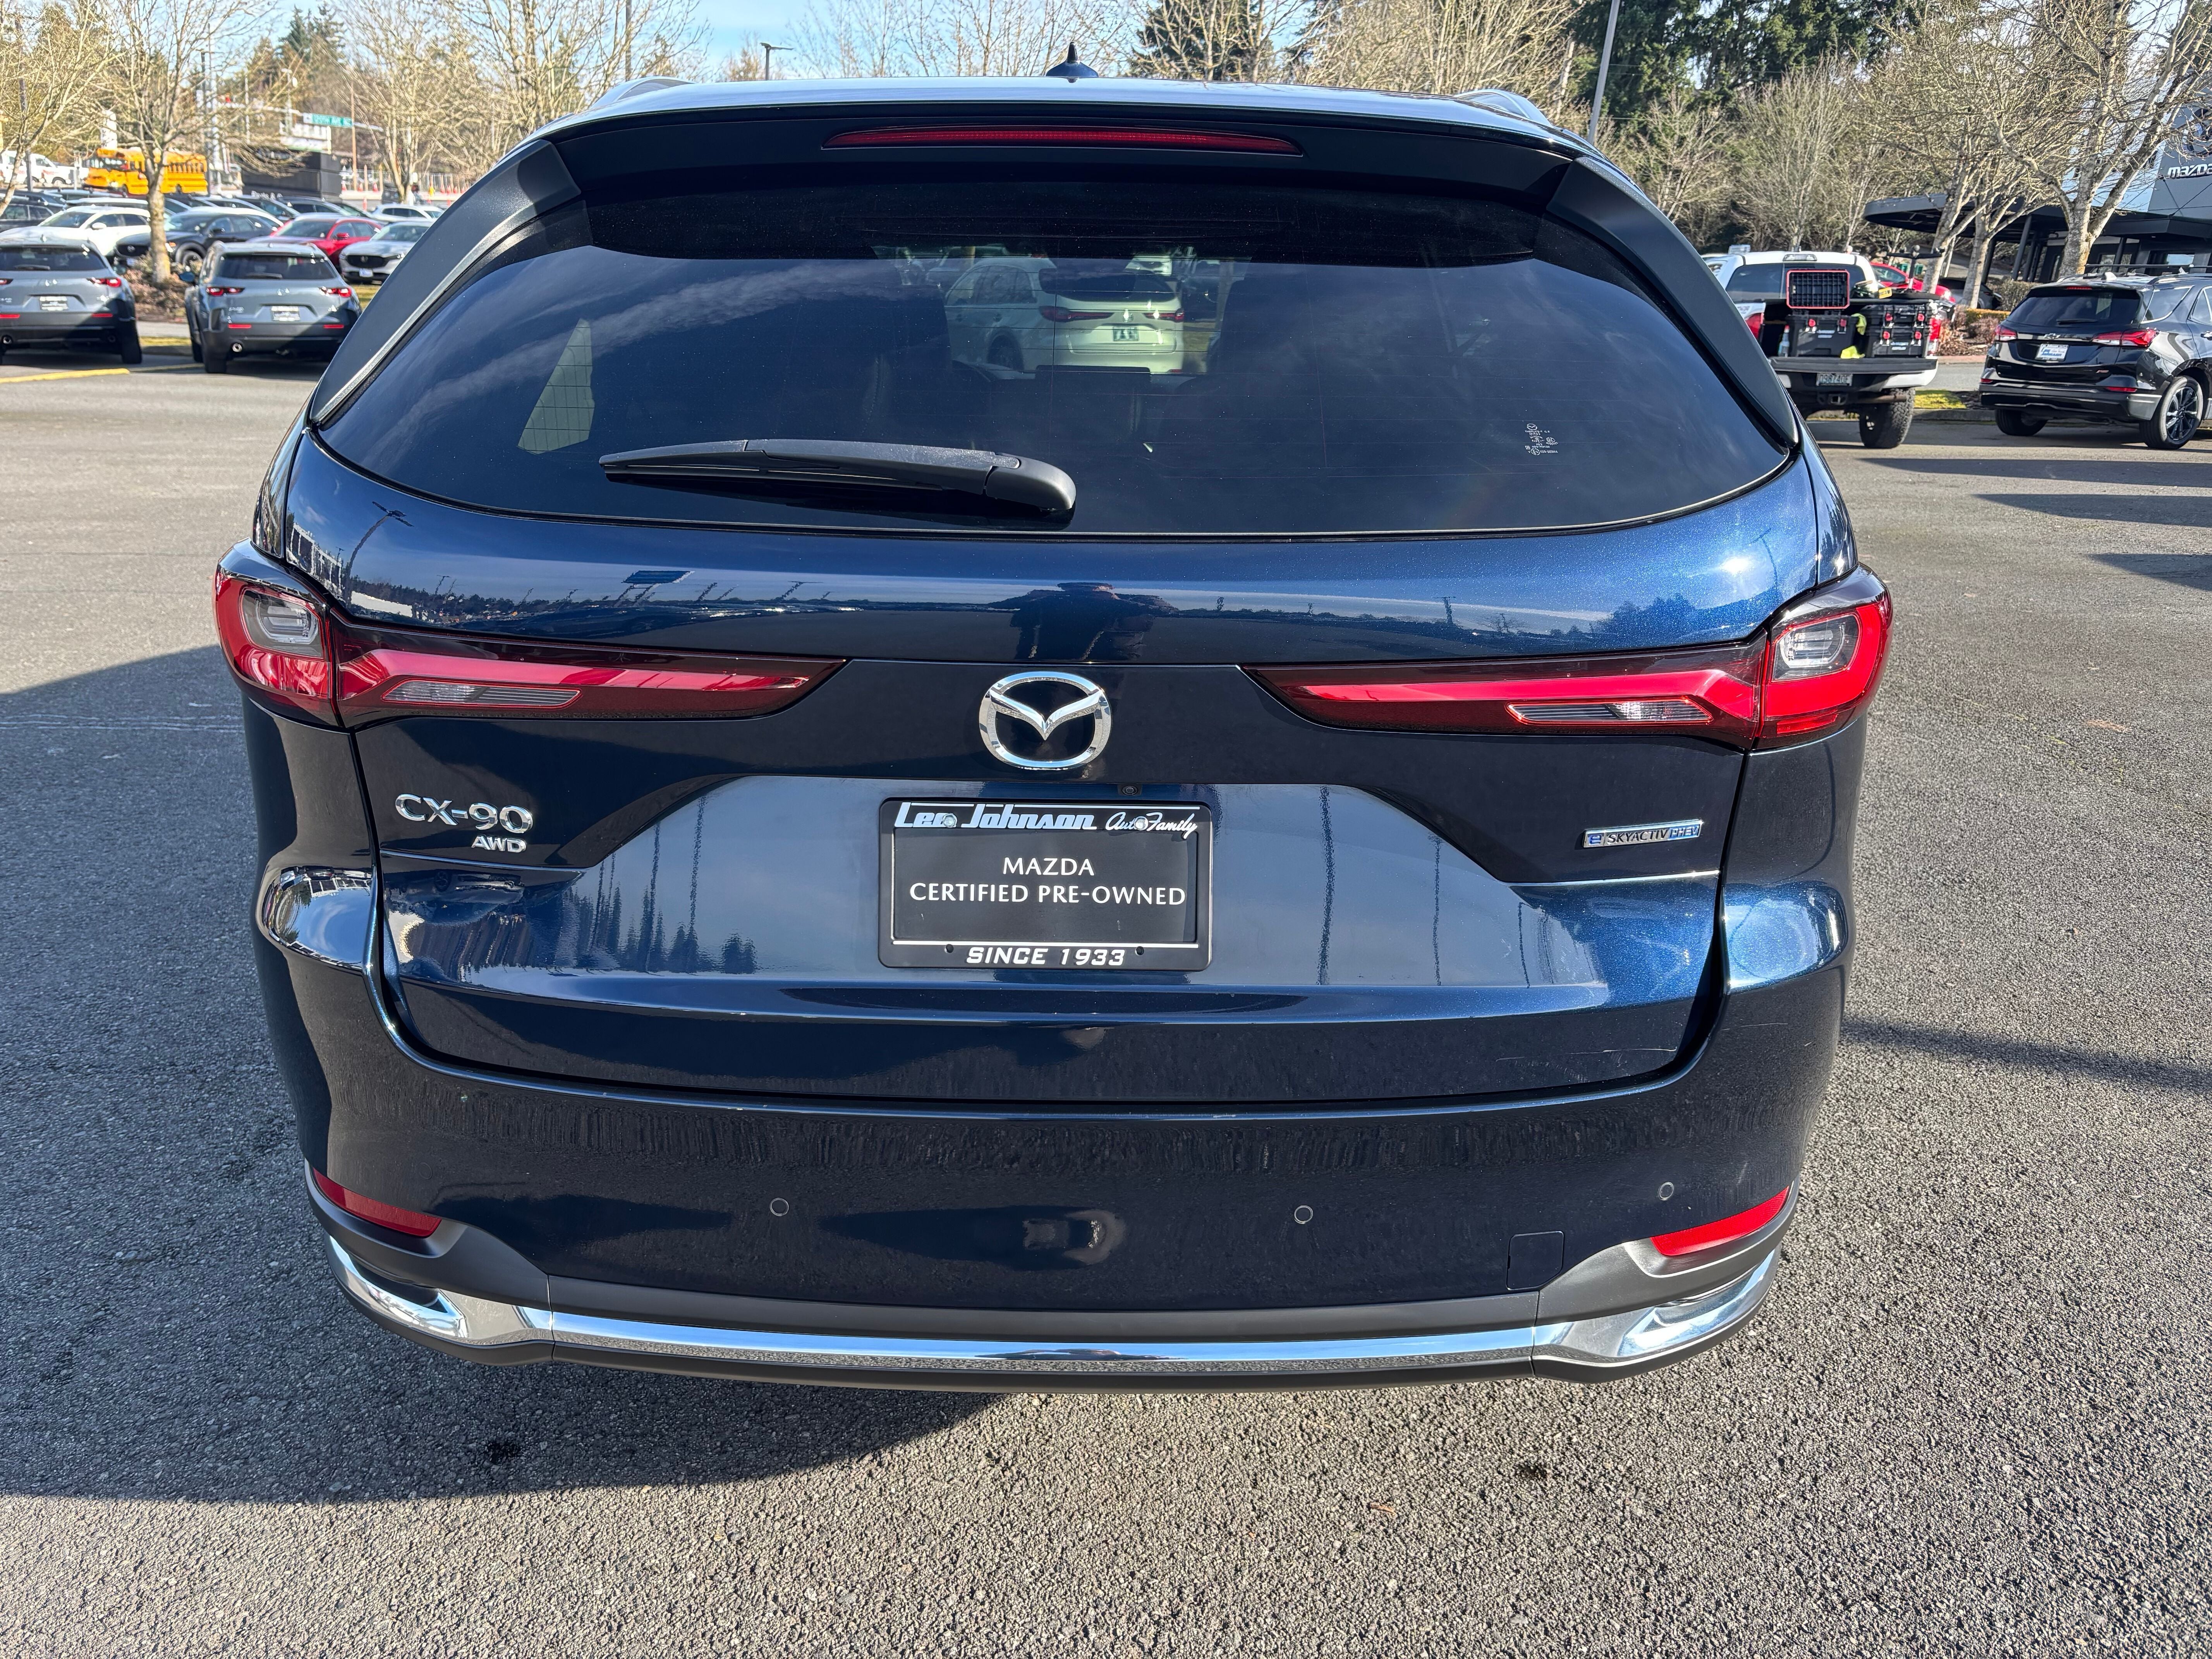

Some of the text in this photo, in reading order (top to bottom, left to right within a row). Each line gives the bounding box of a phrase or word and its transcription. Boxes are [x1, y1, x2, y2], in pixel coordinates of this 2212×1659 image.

[395, 793, 533, 833] CX-90
[961, 804, 1097, 830] Johnson
[1105, 812, 1146, 831] Aut
[1146, 812, 1197, 839] Family
[471, 834, 527, 853] AWD
[1607, 828, 1669, 845] SKYACTIV
[1670, 825, 1700, 838] PHEV
[1003, 857, 1095, 876] MAZDA
[910, 883, 1186, 905] CERTIFIED PRE-OWNED
[966, 947, 1125, 966] SINCE 1933
